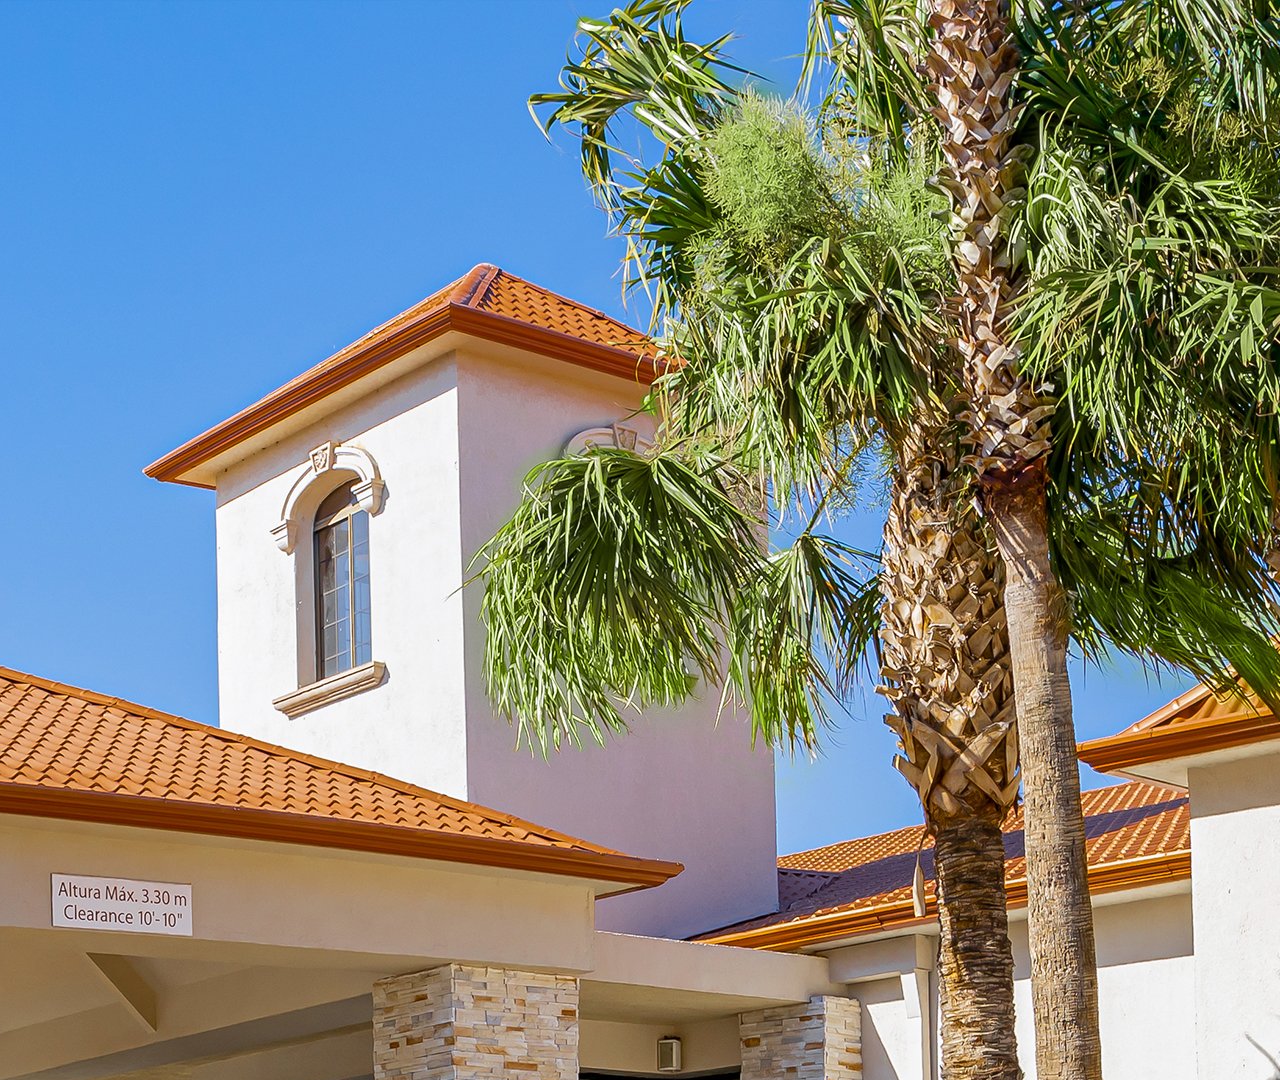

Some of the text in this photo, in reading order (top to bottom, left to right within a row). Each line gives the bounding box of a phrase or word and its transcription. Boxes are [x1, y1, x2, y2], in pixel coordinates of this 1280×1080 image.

[58, 882, 187, 907] Altura Máx. 3.30 m
[63, 904, 134, 925] Clearance
